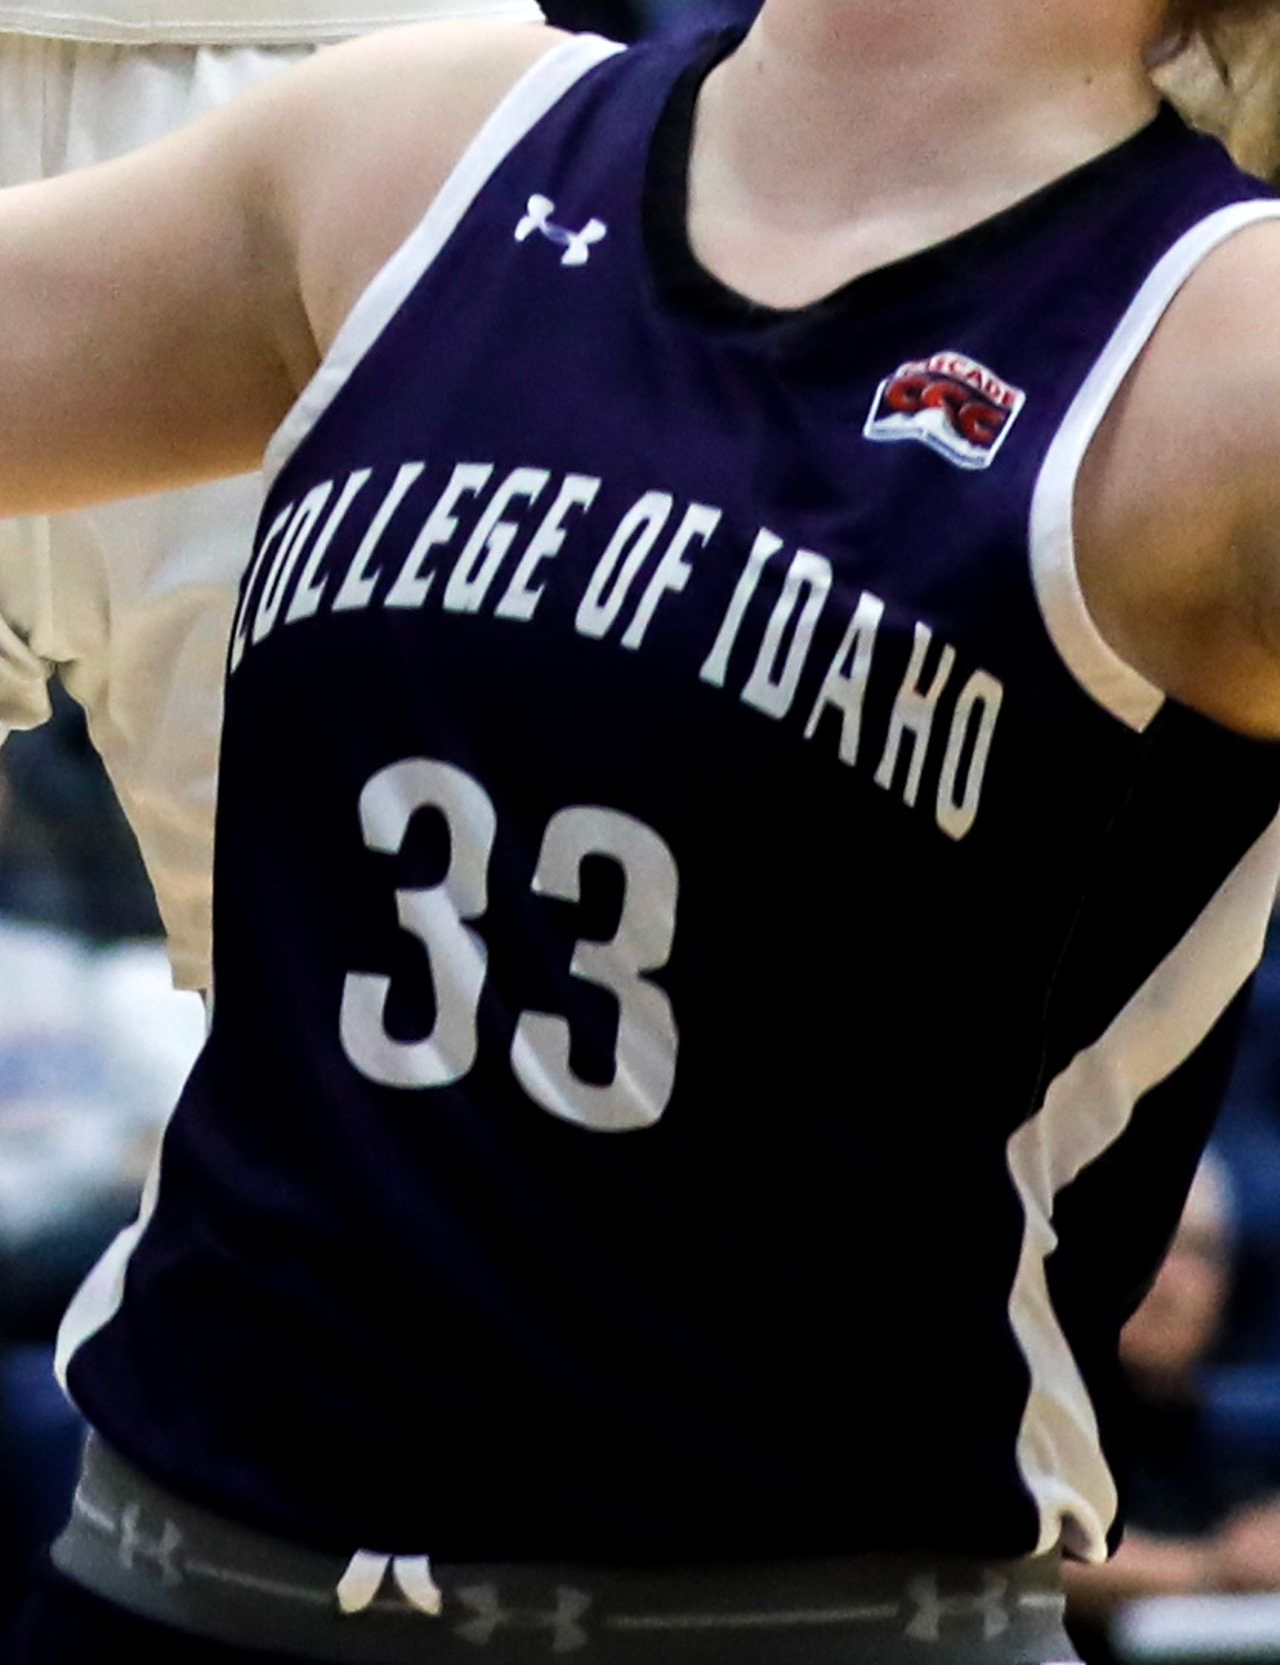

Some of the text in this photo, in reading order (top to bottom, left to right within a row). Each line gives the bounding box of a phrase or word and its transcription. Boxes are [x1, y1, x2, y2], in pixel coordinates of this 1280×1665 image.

[230, 461, 1004, 841] COLLEGE OF IDAHO
[338, 757, 680, 1133] 33
